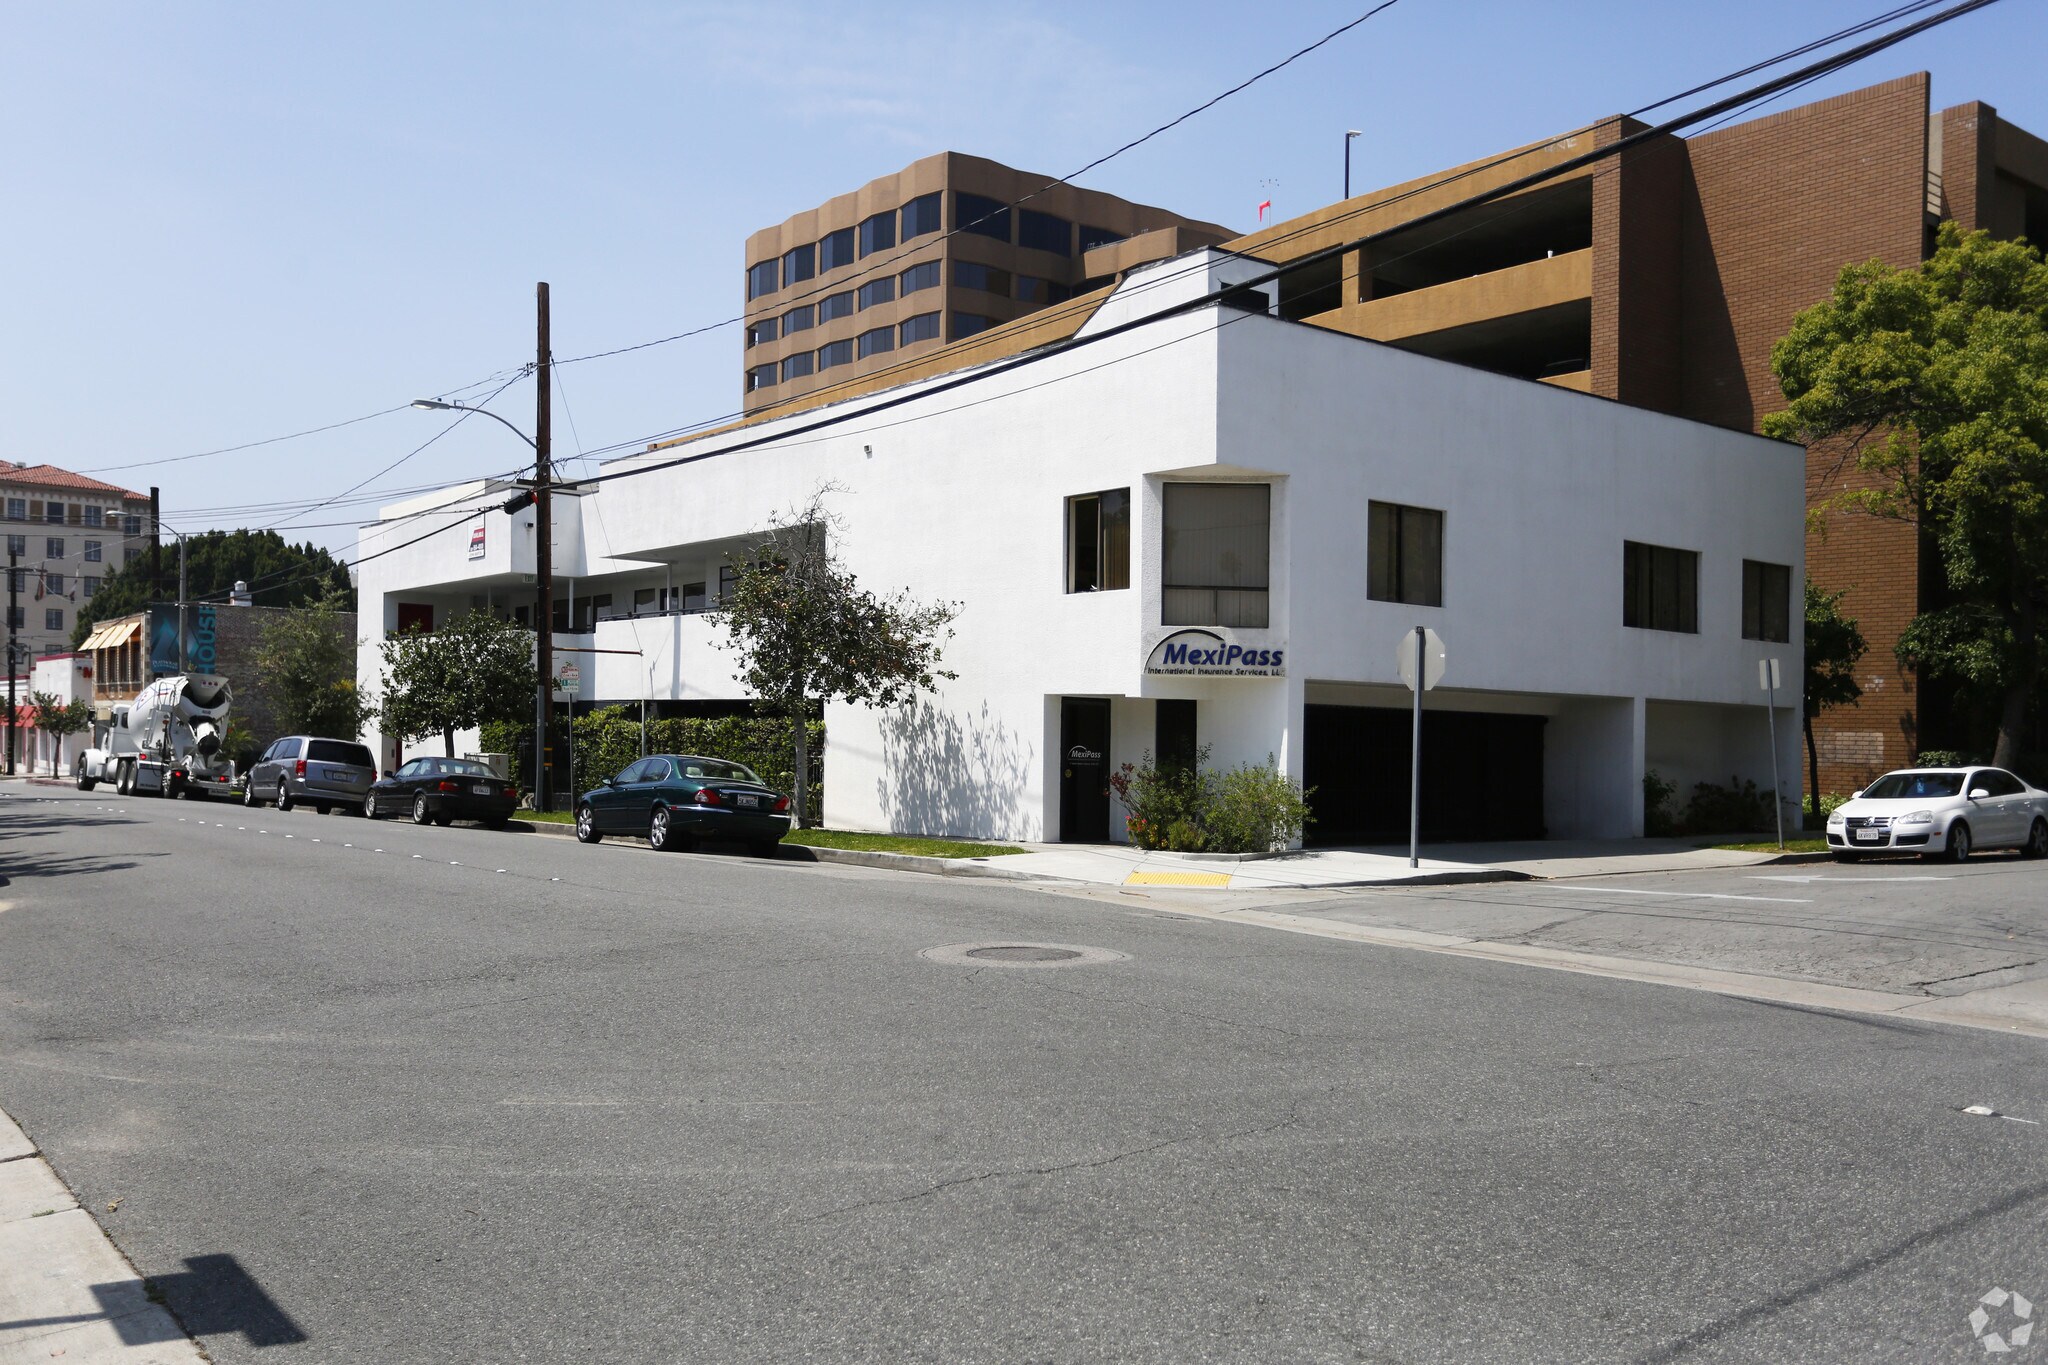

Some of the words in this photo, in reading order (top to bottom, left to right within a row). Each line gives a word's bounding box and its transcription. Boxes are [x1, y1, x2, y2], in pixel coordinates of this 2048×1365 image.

[1163, 643, 1283, 666] MexiPass
[1148, 667, 1195, 675] International
[1071, 750, 1101, 758] MexiPass
